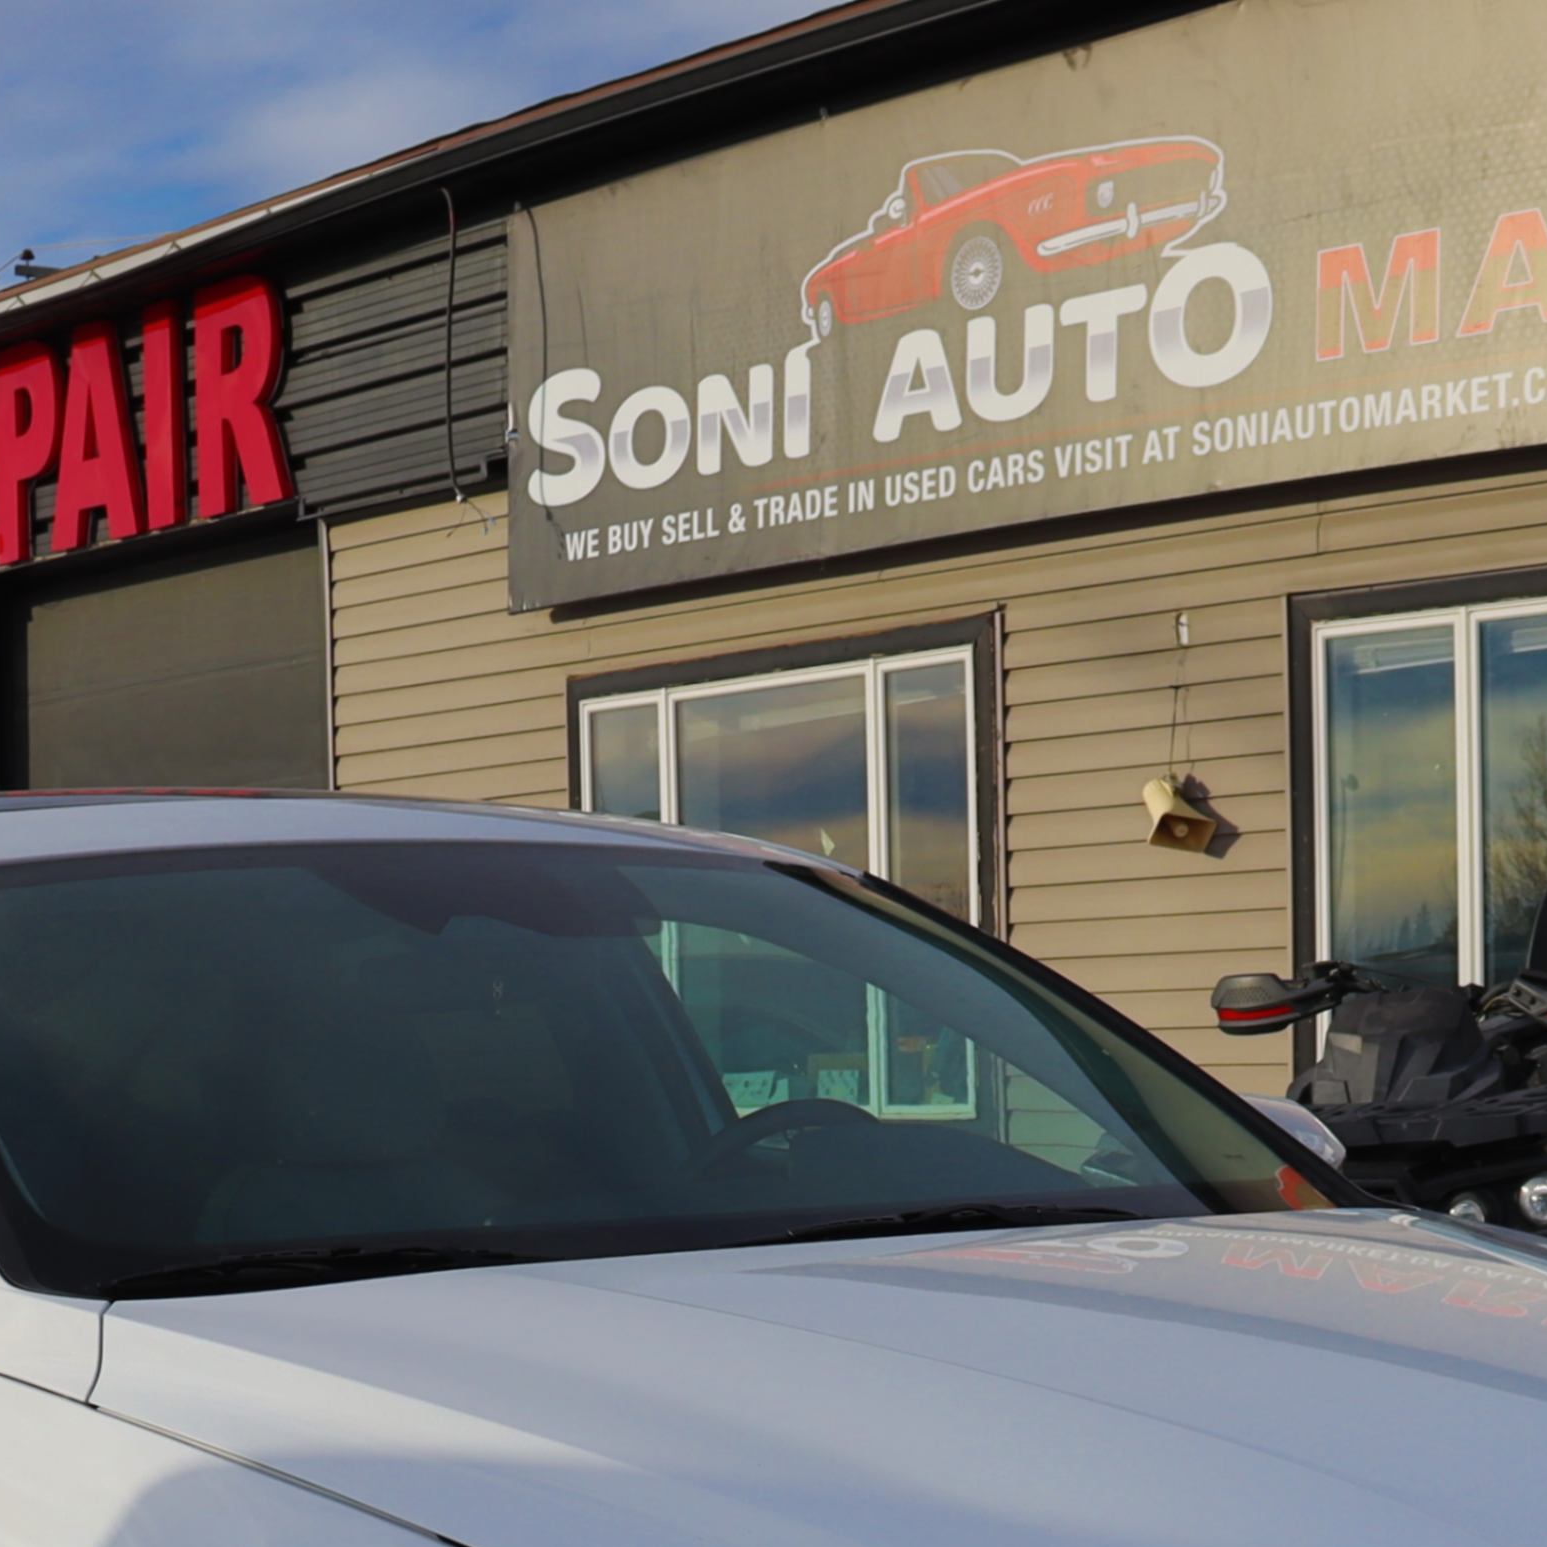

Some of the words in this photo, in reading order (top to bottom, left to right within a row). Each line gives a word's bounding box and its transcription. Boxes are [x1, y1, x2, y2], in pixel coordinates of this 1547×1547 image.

[872, 242, 1272, 442] AUTO
[566, 527, 600, 562] WE
[607, 518, 655, 555] BUY
[661, 507, 720, 545] SELL
[728, 503, 746, 534] &
[753, 485, 839, 529] TRADE
[848, 479, 874, 513] IN
[885, 465, 956, 508] USED
[967, 449, 1045, 493] CARS
[1054, 434, 1133, 479] VISIT
[1142, 426, 1181, 465] AT
